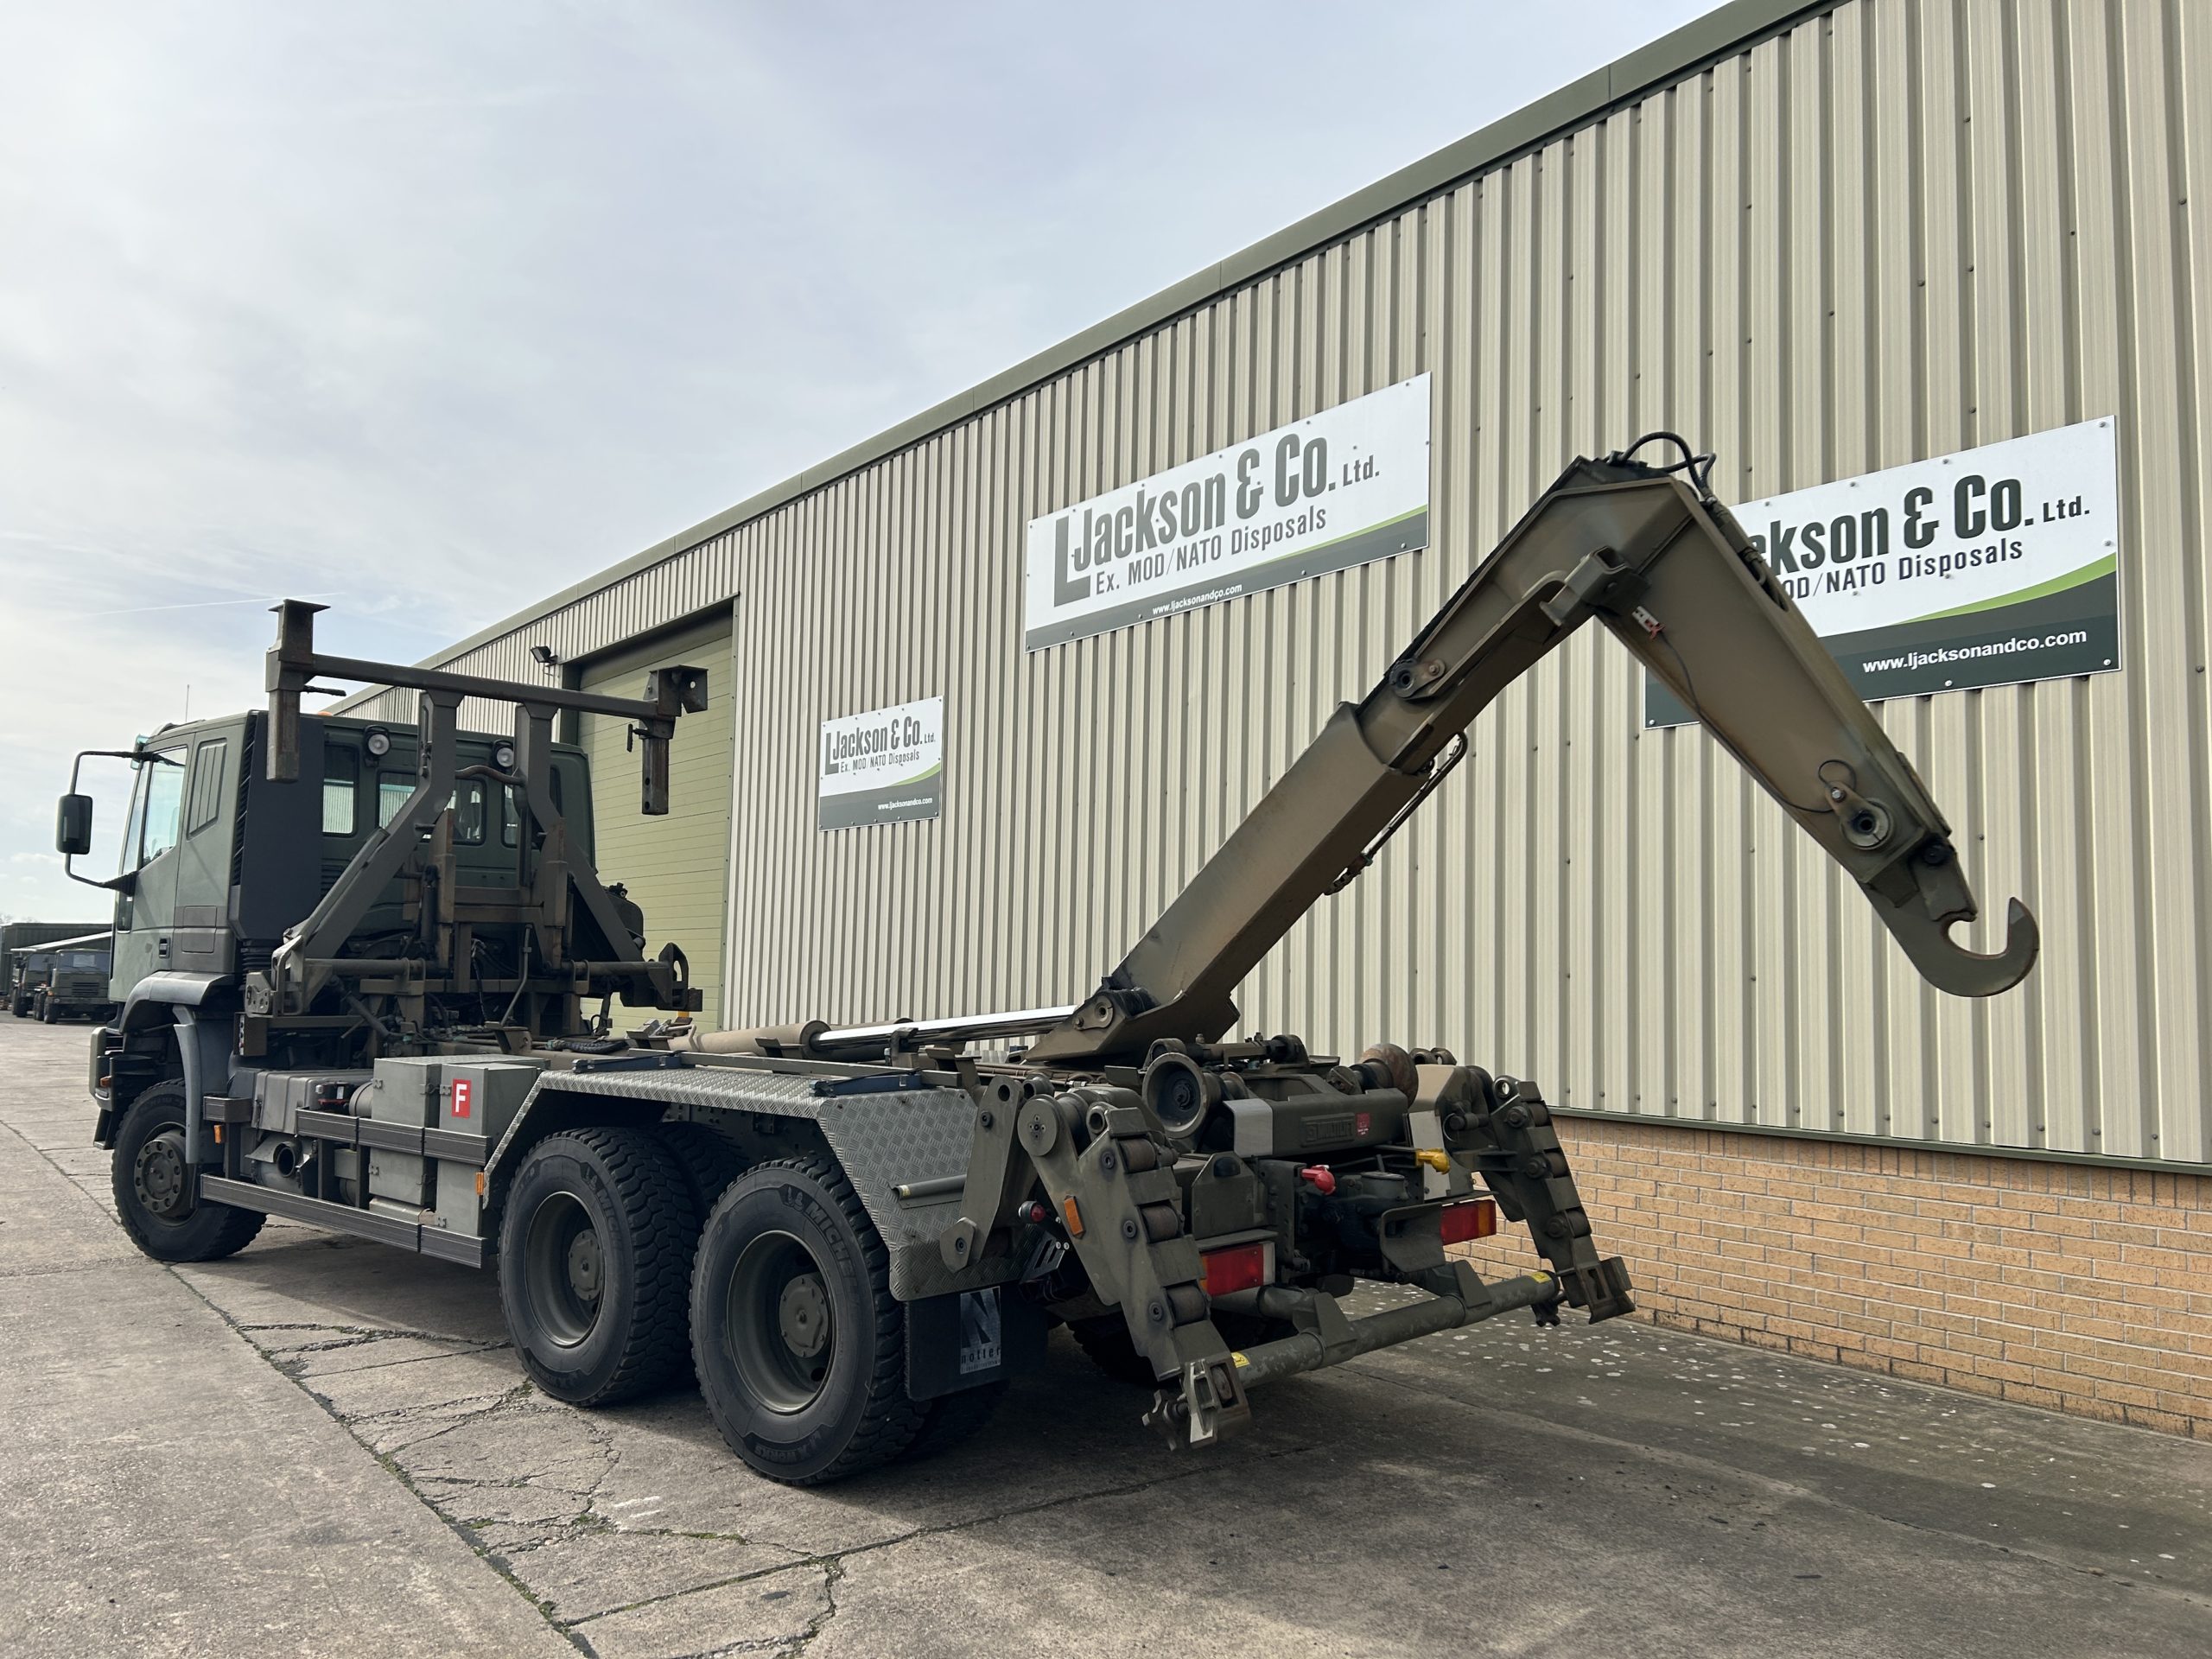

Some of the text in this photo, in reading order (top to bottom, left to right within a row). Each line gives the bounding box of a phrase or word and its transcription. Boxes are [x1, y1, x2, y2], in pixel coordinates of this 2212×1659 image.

[1236, 448, 1264, 519] &
[1274, 433, 1337, 507] Co.
[1343, 454, 1380, 487] Ltd.
[1904, 486, 1939, 549] &
[1954, 474, 2034, 539] Co.
[2043, 495, 2090, 523] Ltd.
[1096, 505, 1326, 595] Ex. MOD/NATO Disposals
[1898, 538, 2022, 580] Disposals
[1862, 630, 2087, 673] www.ljacksonandco.com
[891, 719, 899, 750] &
[903, 715, 923, 747] Co.
[924, 732, 936, 744] Ltd.
[841, 761, 850, 773] Ex.
[888, 749, 919, 766] Disposals
[454, 1083, 467, 1113] F
